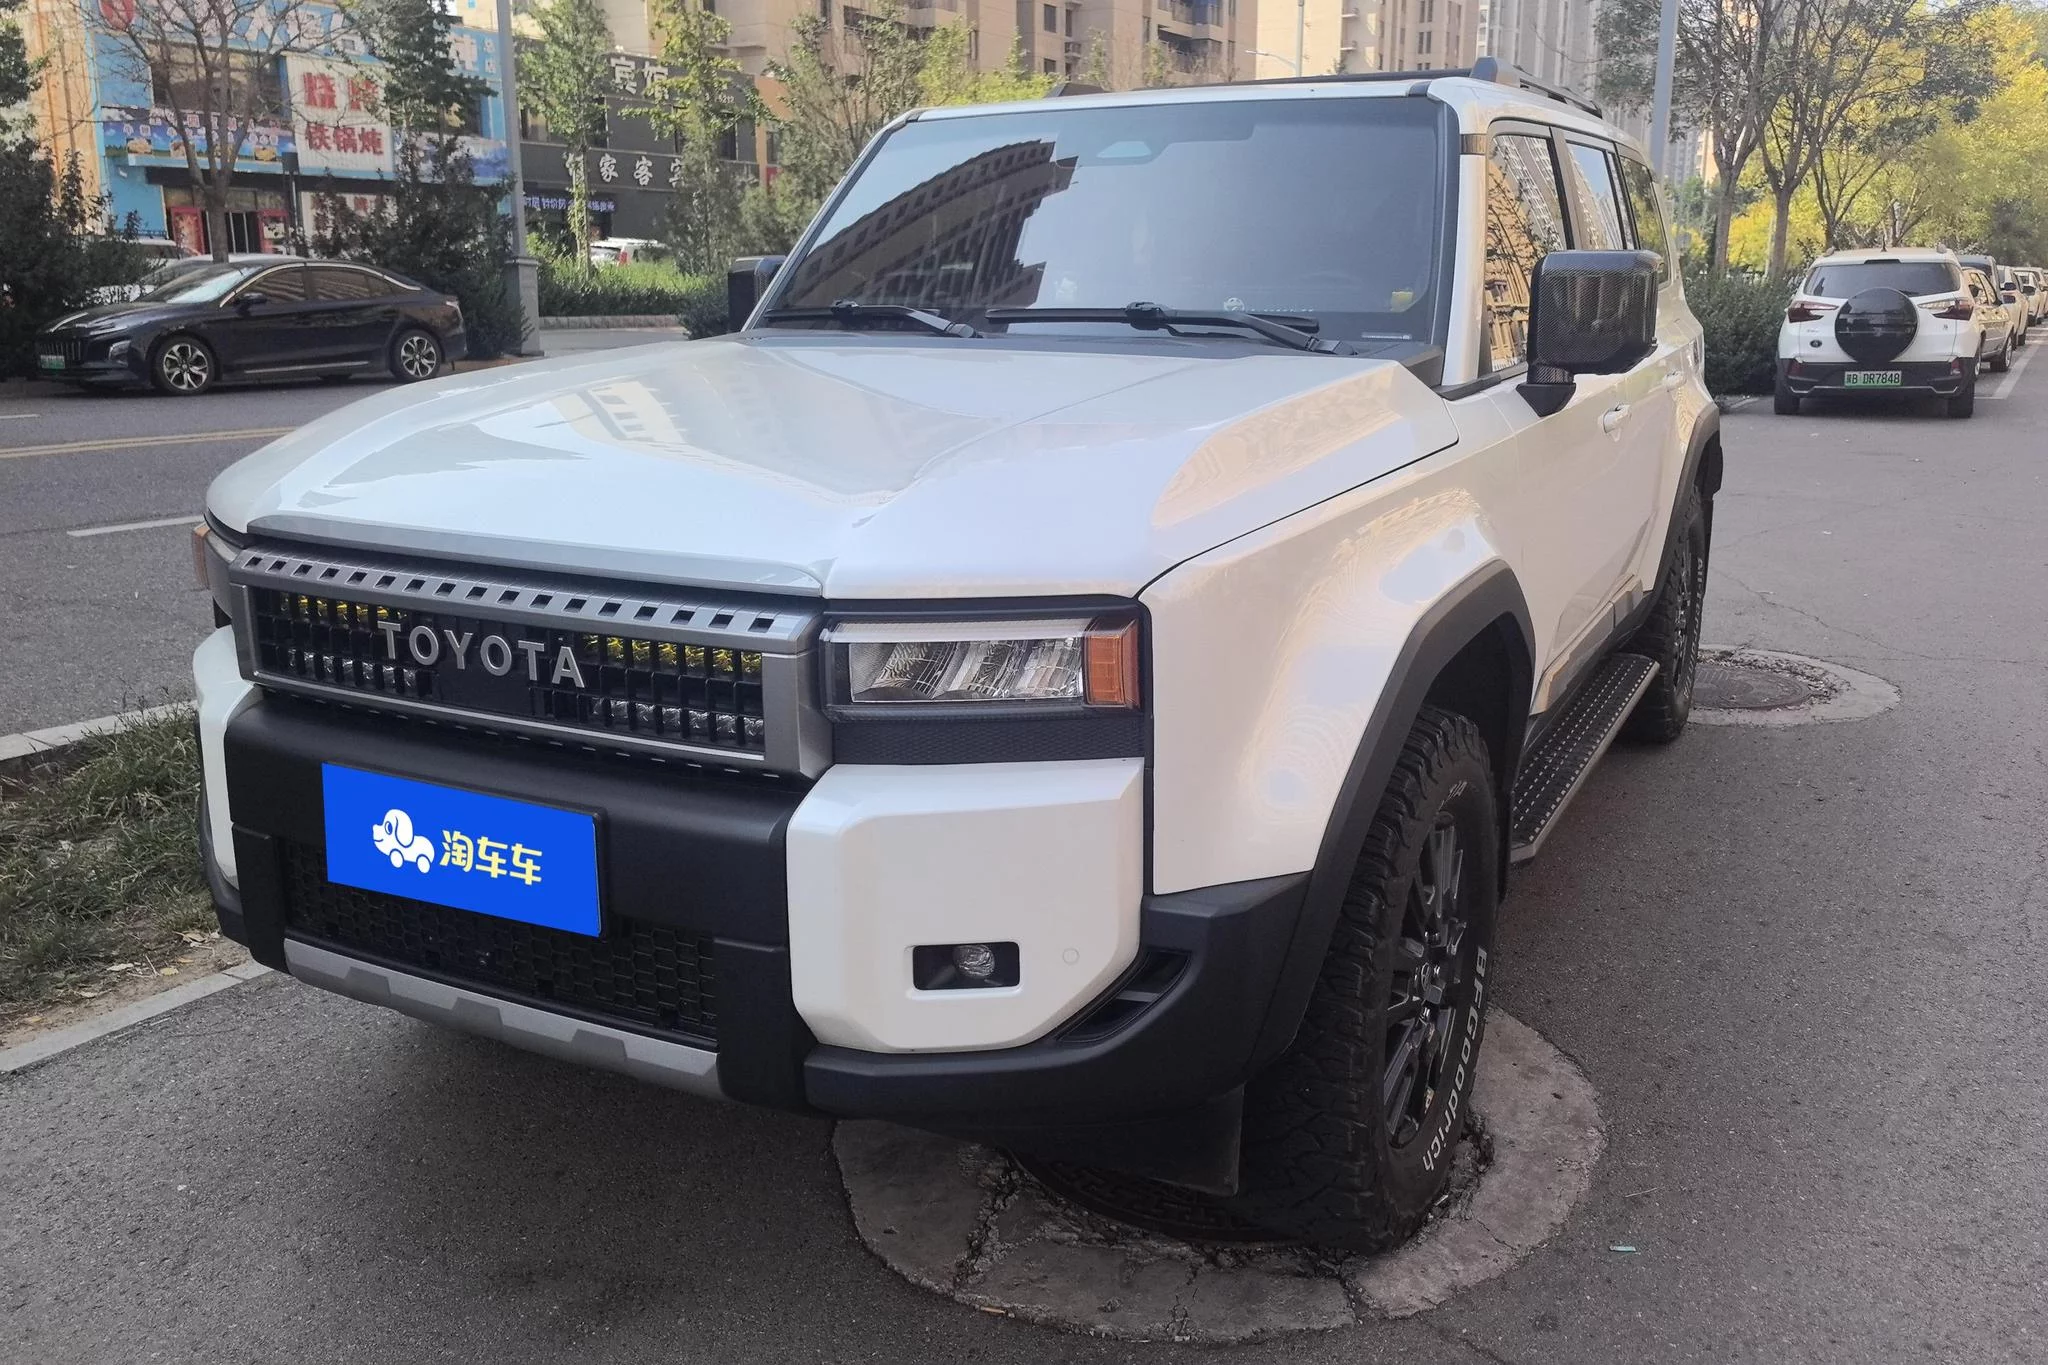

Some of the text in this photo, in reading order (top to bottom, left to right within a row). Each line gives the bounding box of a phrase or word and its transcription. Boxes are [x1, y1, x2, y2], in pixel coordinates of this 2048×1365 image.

[305, 121, 384, 155] 铁锅炖
[1863, 373, 1900, 385] DR7848
[377, 620, 585, 688] TOYOTA
[1422, 946, 1488, 1172] BFGoodrich
